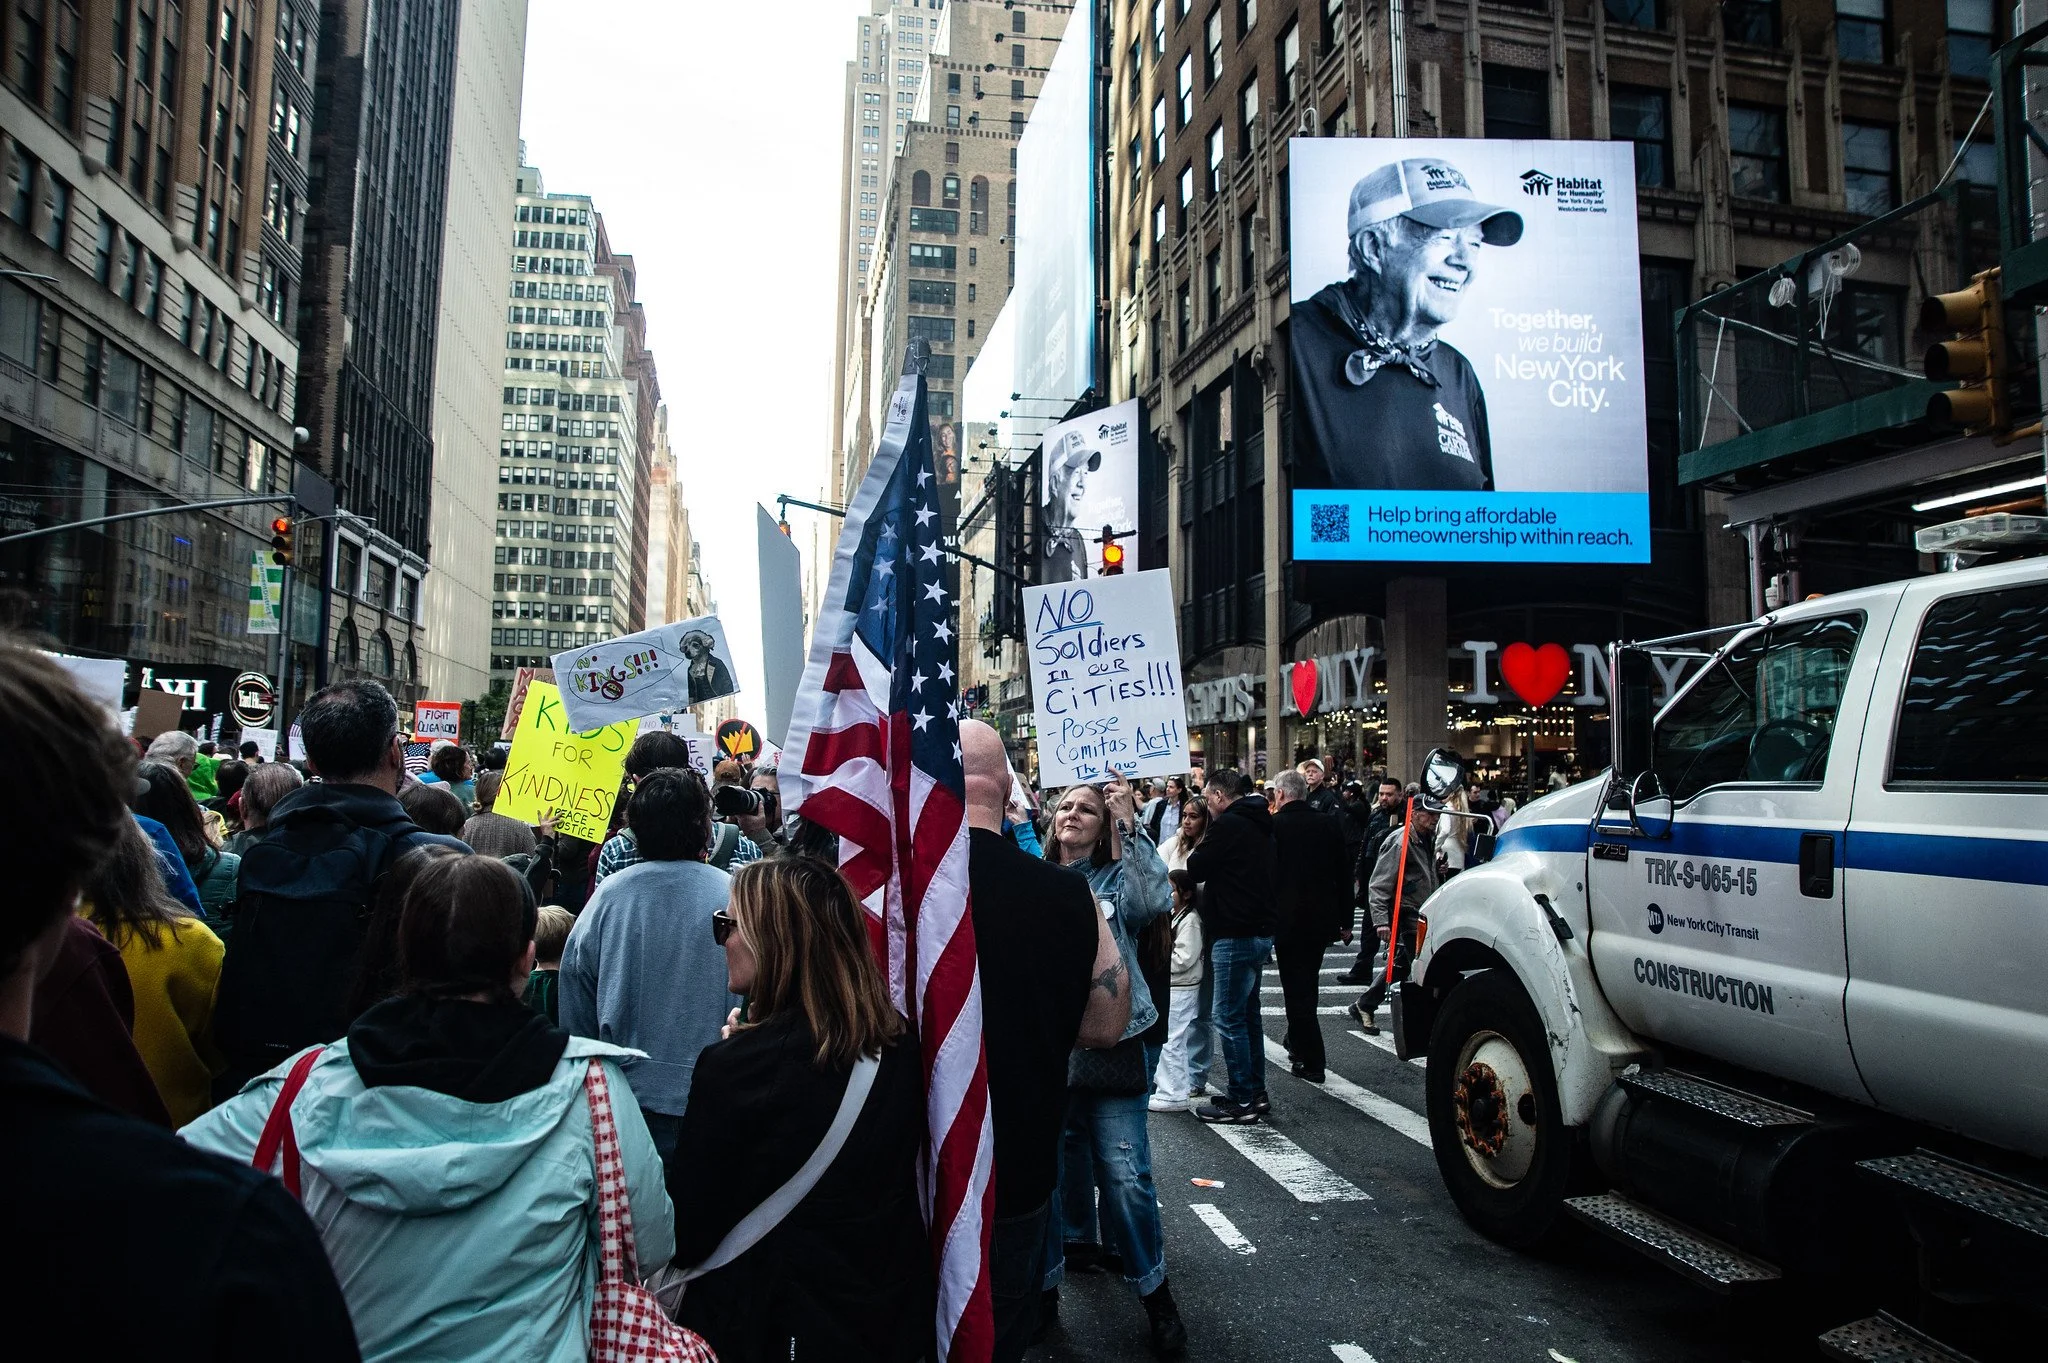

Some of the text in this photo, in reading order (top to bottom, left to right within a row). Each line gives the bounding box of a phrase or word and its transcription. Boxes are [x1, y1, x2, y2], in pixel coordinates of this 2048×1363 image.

[1557, 177, 1602, 189] Habitat
[1570, 190, 1603, 198] Humanity
[1489, 308, 1597, 333] Together,
[1519, 332, 1603, 353] we build
[1495, 353, 1626, 381] New York
[1548, 380, 1610, 413] City.
[1368, 506, 1557, 526] Help bring affordable
[1368, 526, 1633, 547] homeownership within reach.
[1036, 589, 1093, 632] NO
[1036, 626, 1145, 665] Soldiers
[575, 649, 658, 692] KINGS!!!
[1318, 647, 1374, 713] NY
[1462, 641, 1498, 704] I
[425, 709, 451, 720] FIGHT
[644, 720, 657, 729] NO
[1137, 720, 1180, 752] Act!
[552, 741, 593, 769] FOR
[1072, 760, 1137, 777] The Law
[553, 820, 596, 839] USTICE
[554, 807, 588, 826] PEACE
[1645, 857, 1757, 896] TRK-S-065-15
[1667, 914, 1760, 940] New York City Transit
[1634, 957, 1775, 1015] CONSTRUCTION
